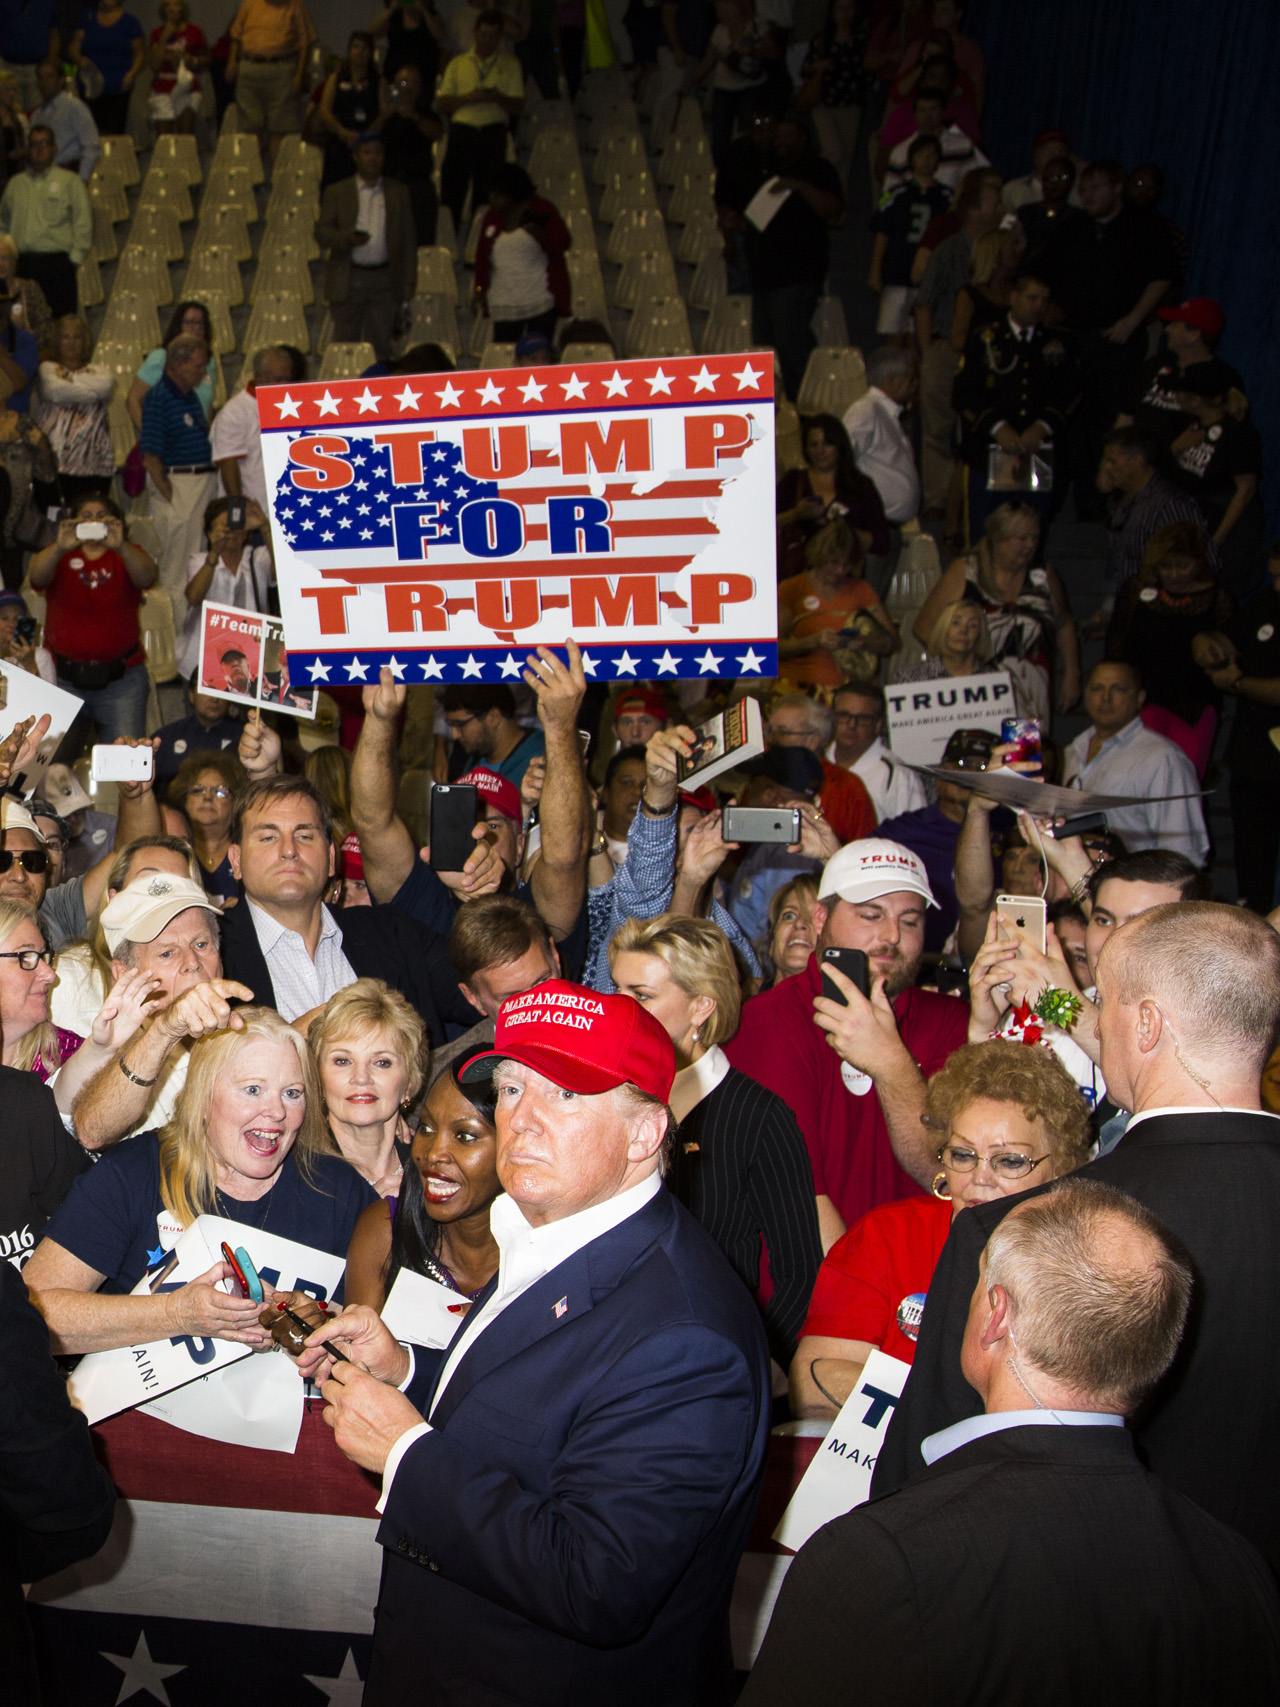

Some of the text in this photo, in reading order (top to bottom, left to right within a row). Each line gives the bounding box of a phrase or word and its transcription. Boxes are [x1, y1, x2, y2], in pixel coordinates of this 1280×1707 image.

[287, 412, 754, 493] STUMP
[389, 494, 615, 563] FOR
[299, 571, 757, 636] TRUMP
[889, 683, 1010, 713] TRUMP
[729, 701, 742, 747] TRUMP
[860, 855, 918, 868] TRUMP
[502, 992, 605, 1016] MAKE AMERICA
[504, 1009, 594, 1031] GREAT AGAIN
[158, 1224, 184, 1233] TRUM
[827, 1438, 877, 1470] MAK
